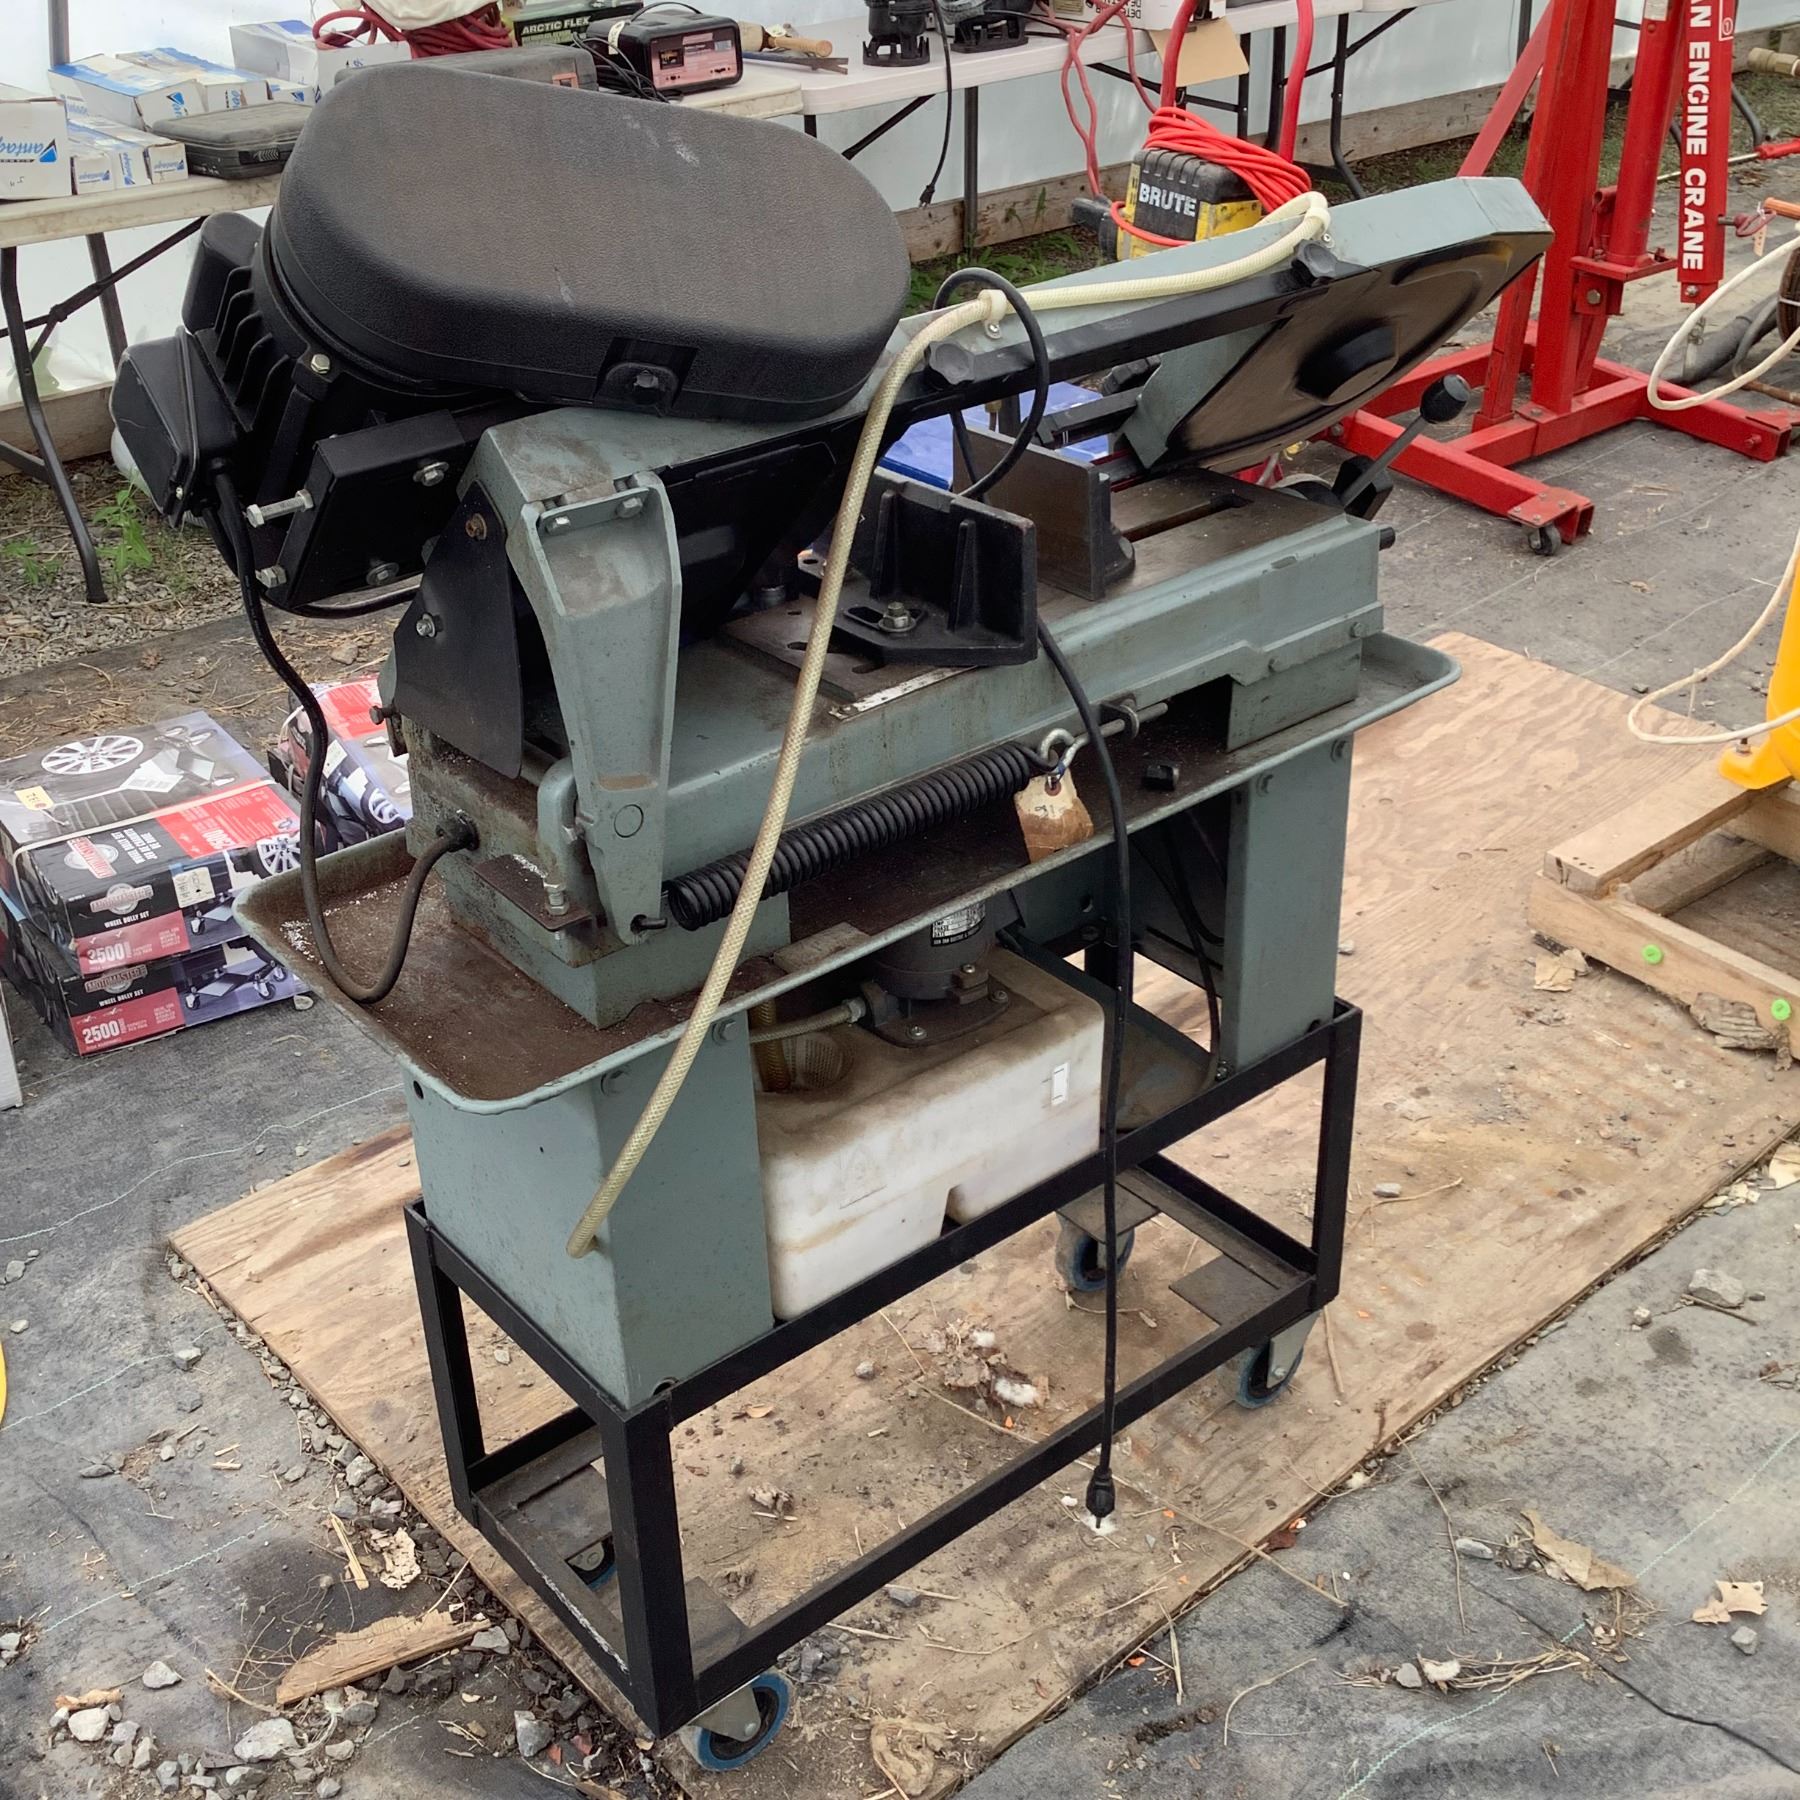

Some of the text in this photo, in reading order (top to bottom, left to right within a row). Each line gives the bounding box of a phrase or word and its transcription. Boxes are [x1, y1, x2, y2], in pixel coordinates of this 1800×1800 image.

[521, 16, 591, 35] ARCTIC FLEX
[1682, 0, 1712, 270] N ENGINE CRANE
[1139, 182, 1197, 217] BRUTE
[82, 1020, 120, 1045] 2500
